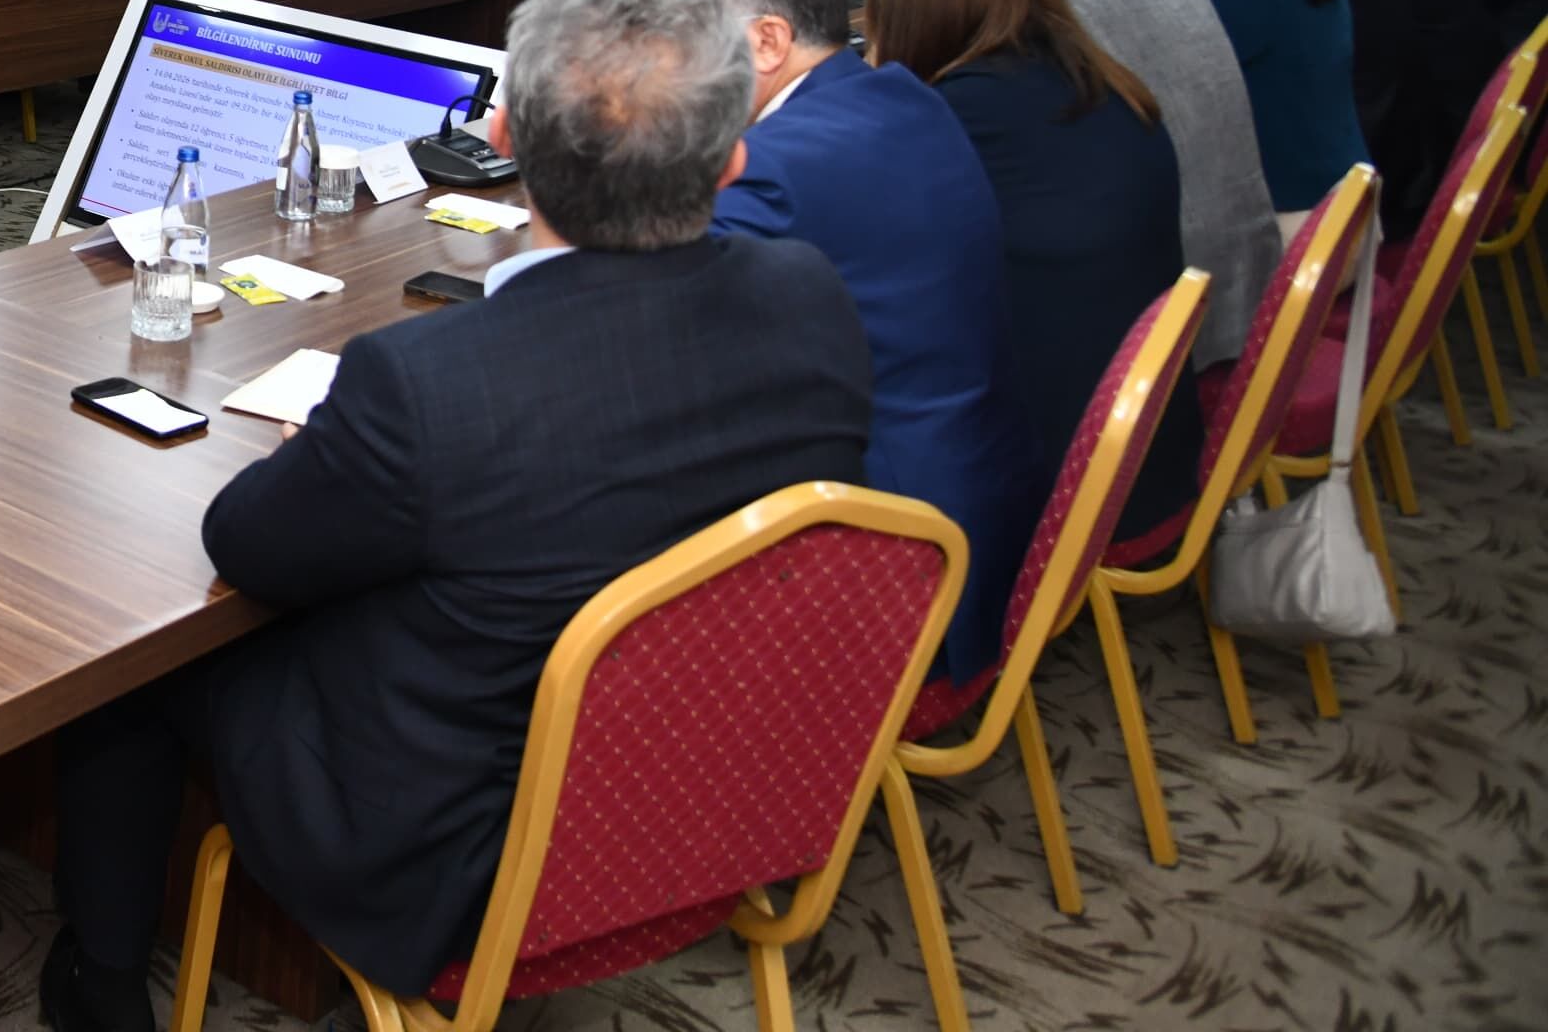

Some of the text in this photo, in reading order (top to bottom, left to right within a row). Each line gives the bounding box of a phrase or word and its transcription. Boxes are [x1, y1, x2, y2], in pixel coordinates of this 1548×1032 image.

[195, 25, 275, 53] BİLGİLENDİRME
[275, 45, 321, 64] SUNUMU
[326, 88, 348, 99] BİLGİ
